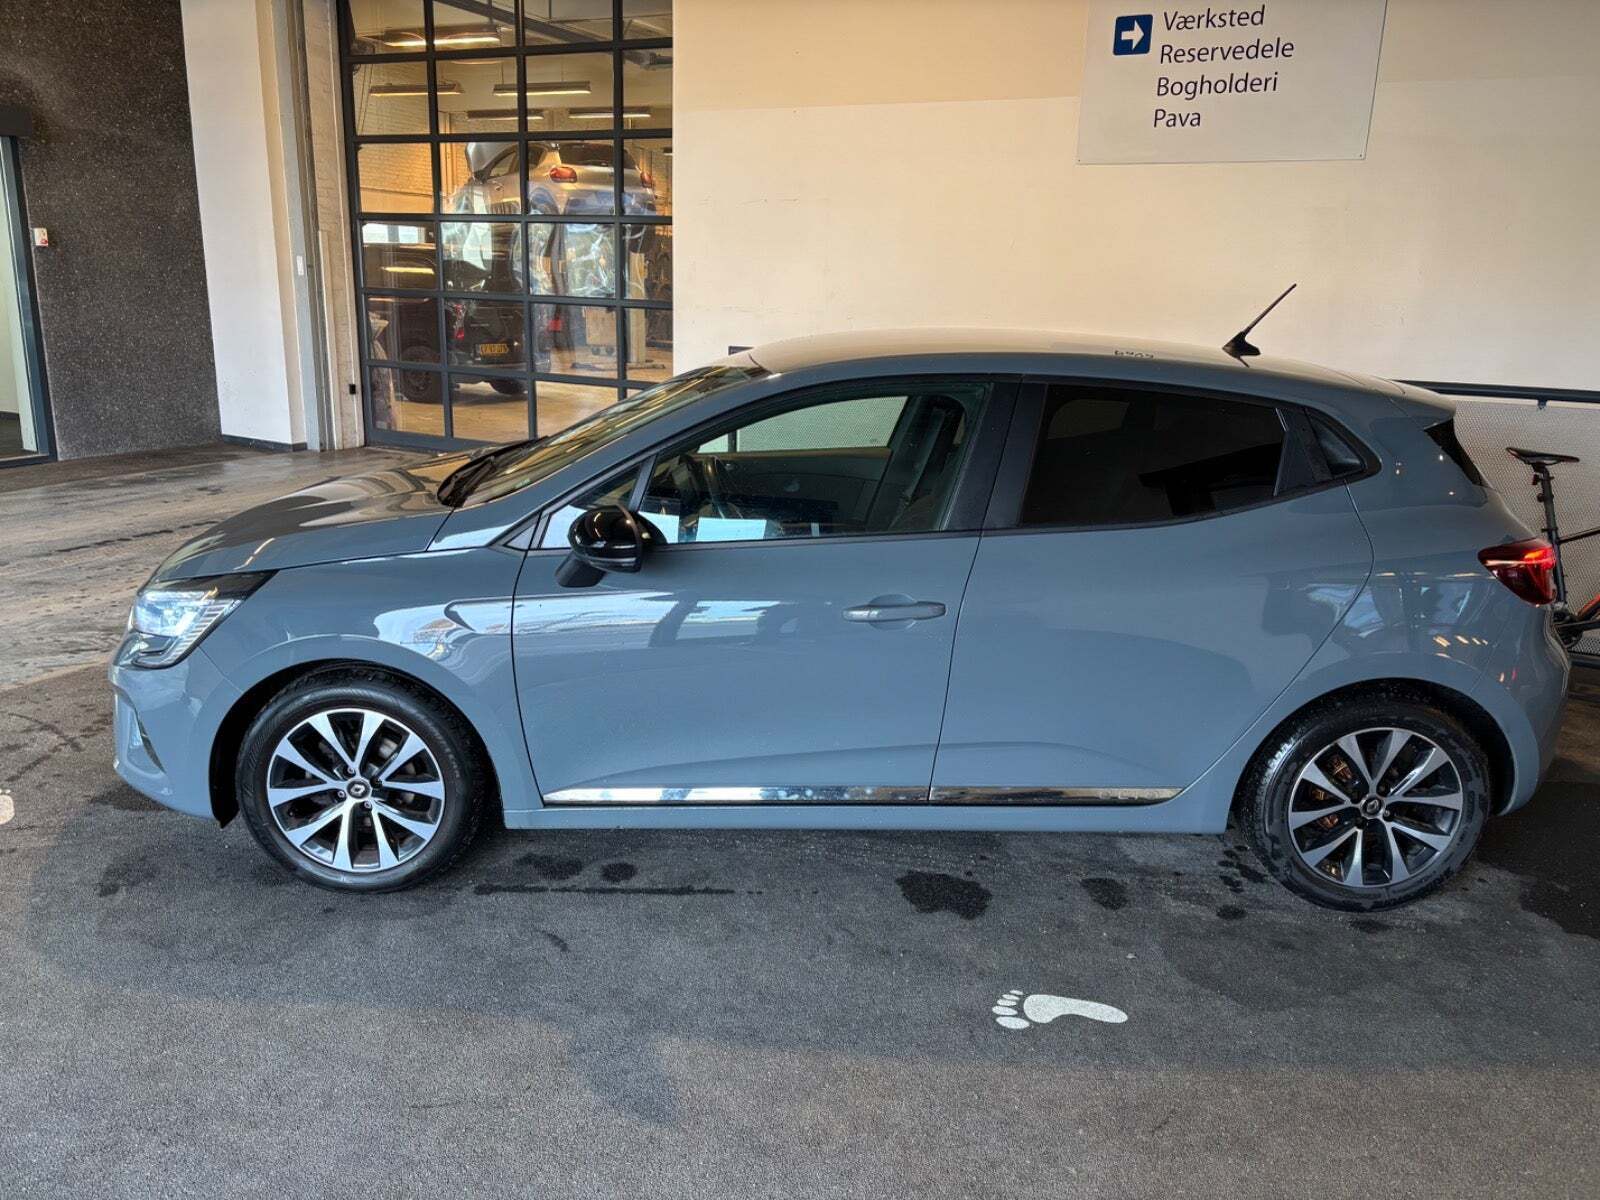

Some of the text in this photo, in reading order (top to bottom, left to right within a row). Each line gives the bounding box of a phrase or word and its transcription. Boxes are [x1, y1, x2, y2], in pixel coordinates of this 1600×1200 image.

[1163, 4, 1265, 31] Værksted
[1159, 37, 1295, 64] Reservedele
[1156, 71, 1279, 101] Bogholderi
[1153, 108, 1201, 128] Pava
